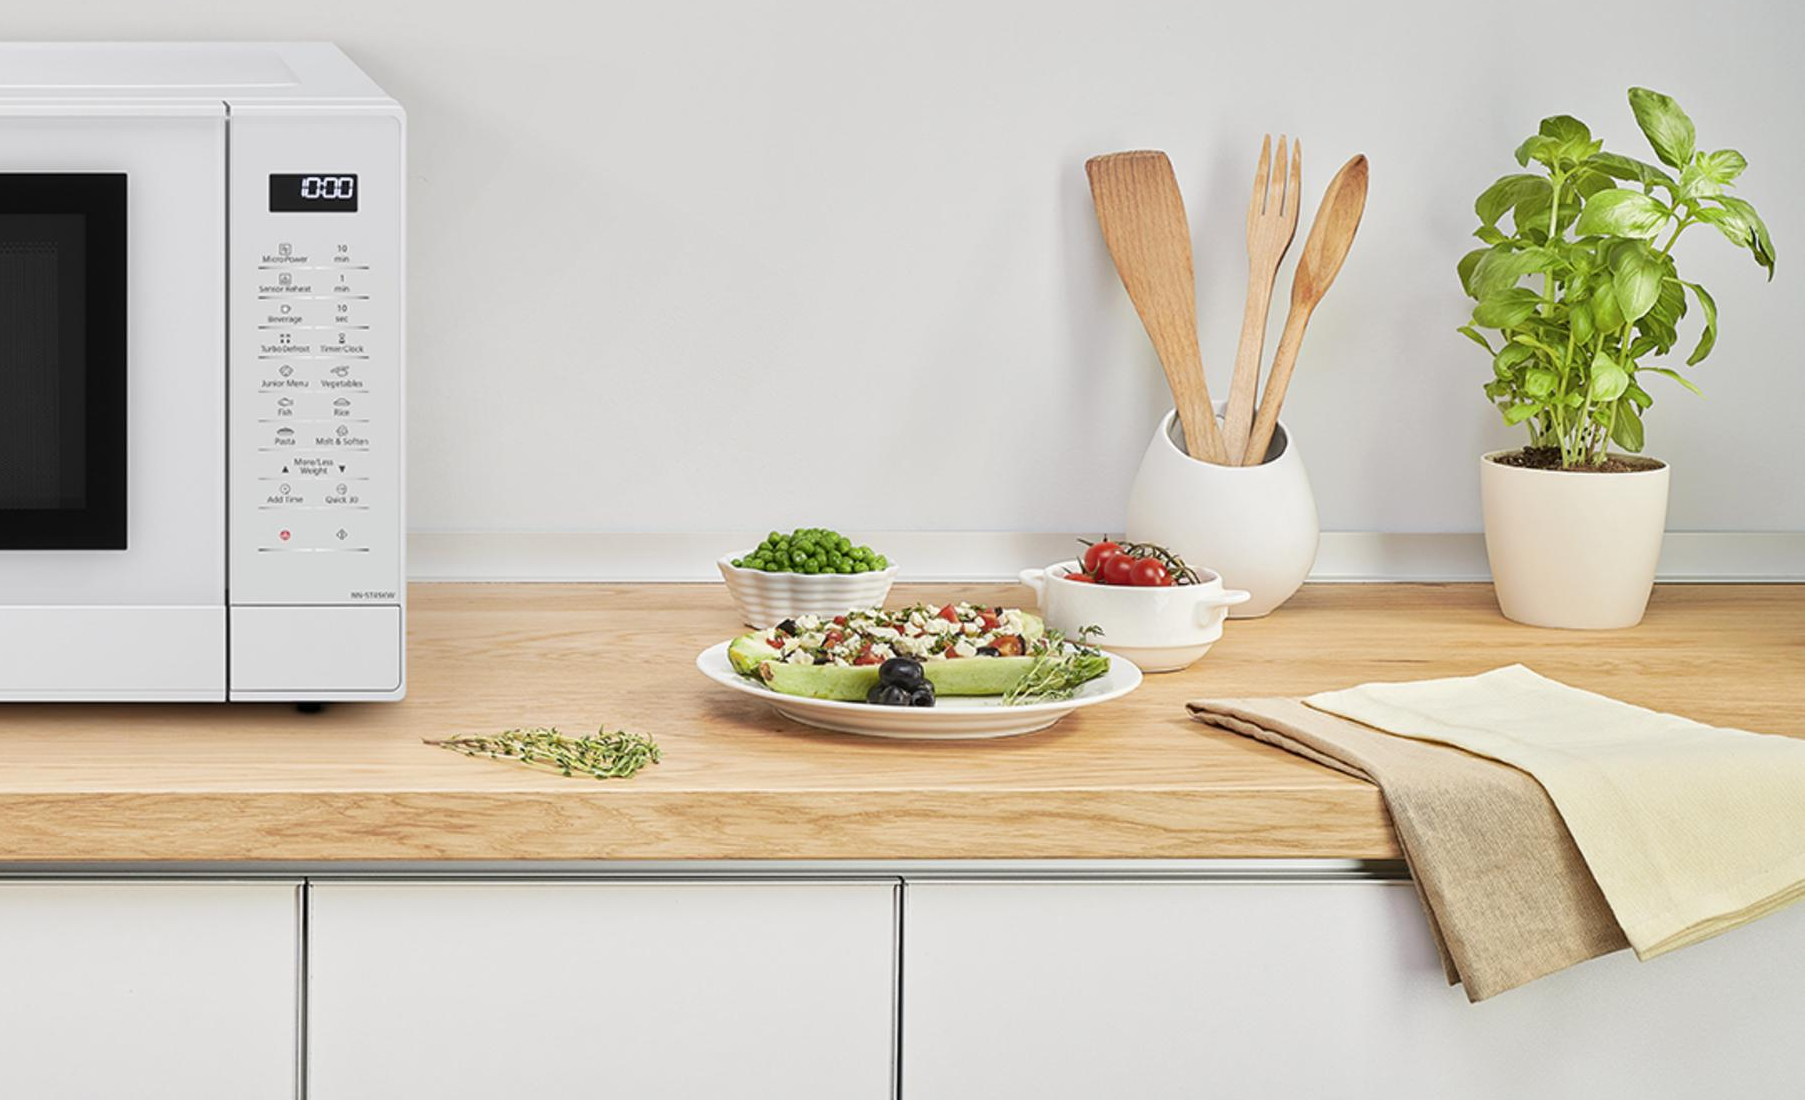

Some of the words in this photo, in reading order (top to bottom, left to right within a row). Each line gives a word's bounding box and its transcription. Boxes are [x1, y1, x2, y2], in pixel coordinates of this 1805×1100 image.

[301, 177, 353, 198] 10:00
[337, 245, 348, 253] 10
[259, 285, 284, 293] Sensor
[337, 304, 348, 312] 10
[267, 315, 303, 324] Beverage
[335, 315, 348, 323] sec
[261, 379, 284, 388] Junior
[286, 379, 309, 388] Menu
[321, 379, 363, 389] Vegetables
[278, 408, 293, 416] Fish
[334, 408, 349, 416] Rice
[274, 437, 296, 445] Pasta
[335, 437, 341, 445] &
[343, 437, 369, 445] Soften
[300, 466, 328, 476] Weight
[267, 495, 283, 504] Add
[284, 495, 304, 504] Time
[325, 495, 347, 504] Quick
